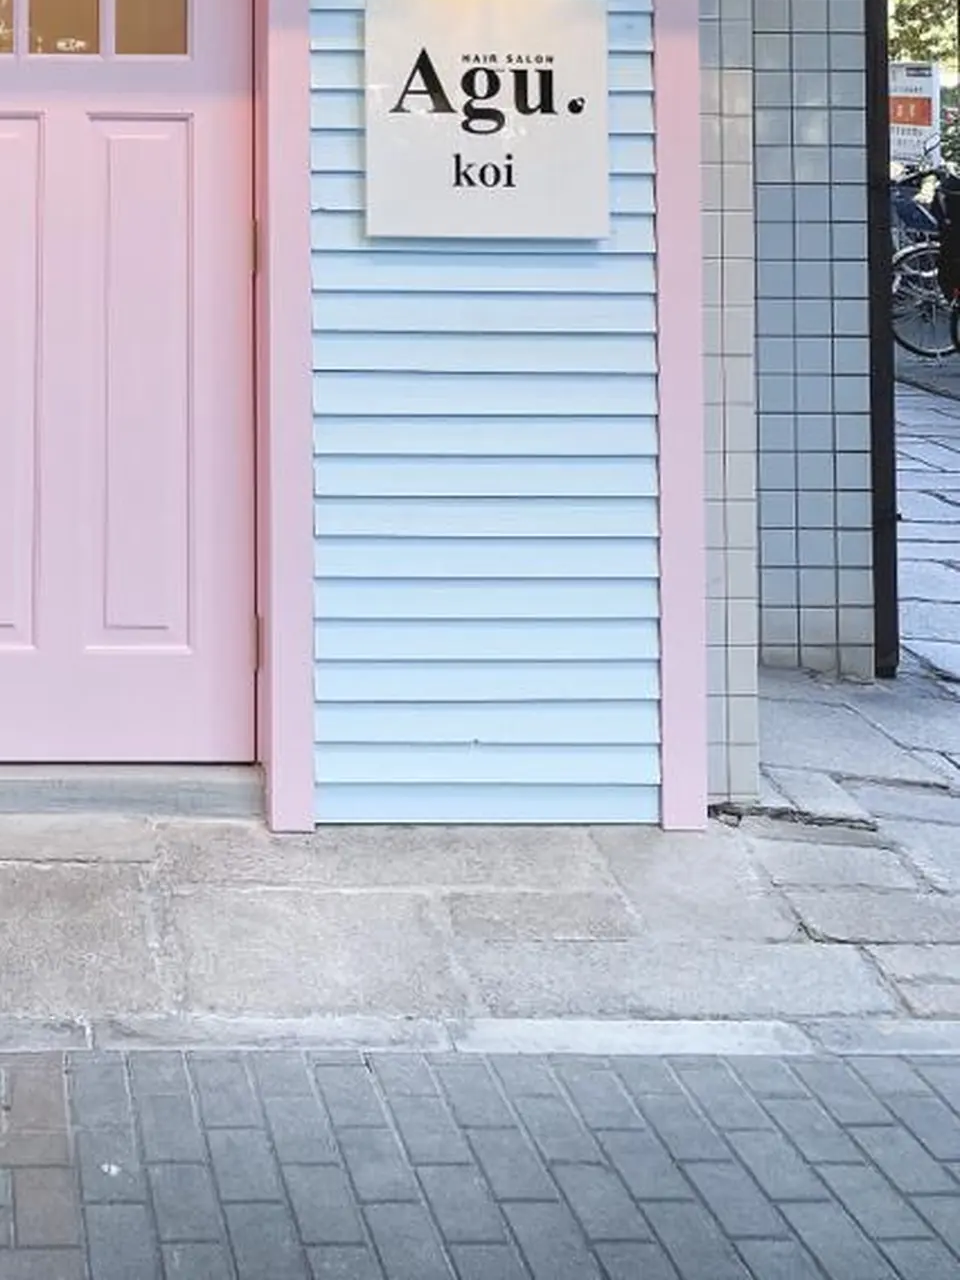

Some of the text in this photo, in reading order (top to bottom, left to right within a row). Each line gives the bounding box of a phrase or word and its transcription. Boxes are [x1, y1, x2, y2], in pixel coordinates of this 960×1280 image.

[461, 53, 555, 64] HAIR SALON
[388, 46, 586, 135] Agu.
[452, 153, 517, 188] koi
